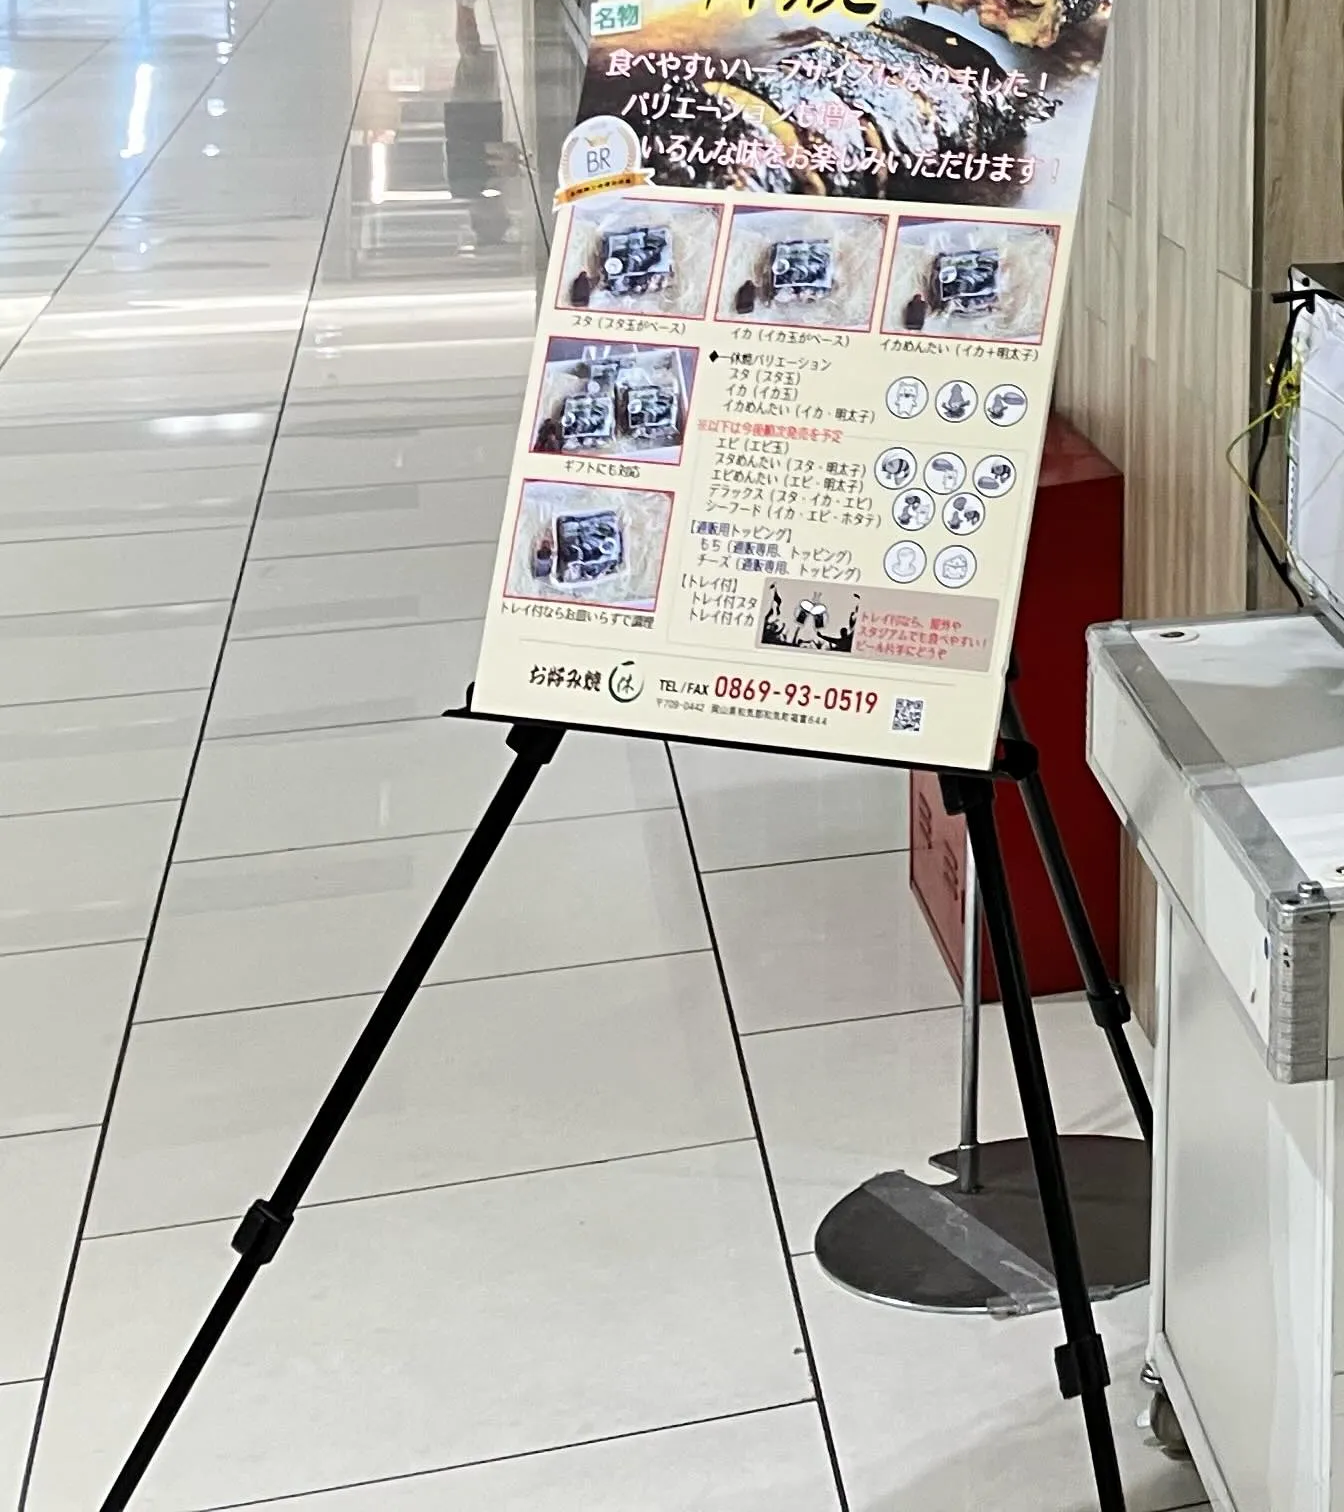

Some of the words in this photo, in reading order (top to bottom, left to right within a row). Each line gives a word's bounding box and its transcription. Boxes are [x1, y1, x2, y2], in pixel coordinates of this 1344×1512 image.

[594, 3, 640, 31] 名物
[587, 147, 611, 174] BR
[714, 675, 879, 715] 0869-93-0519
